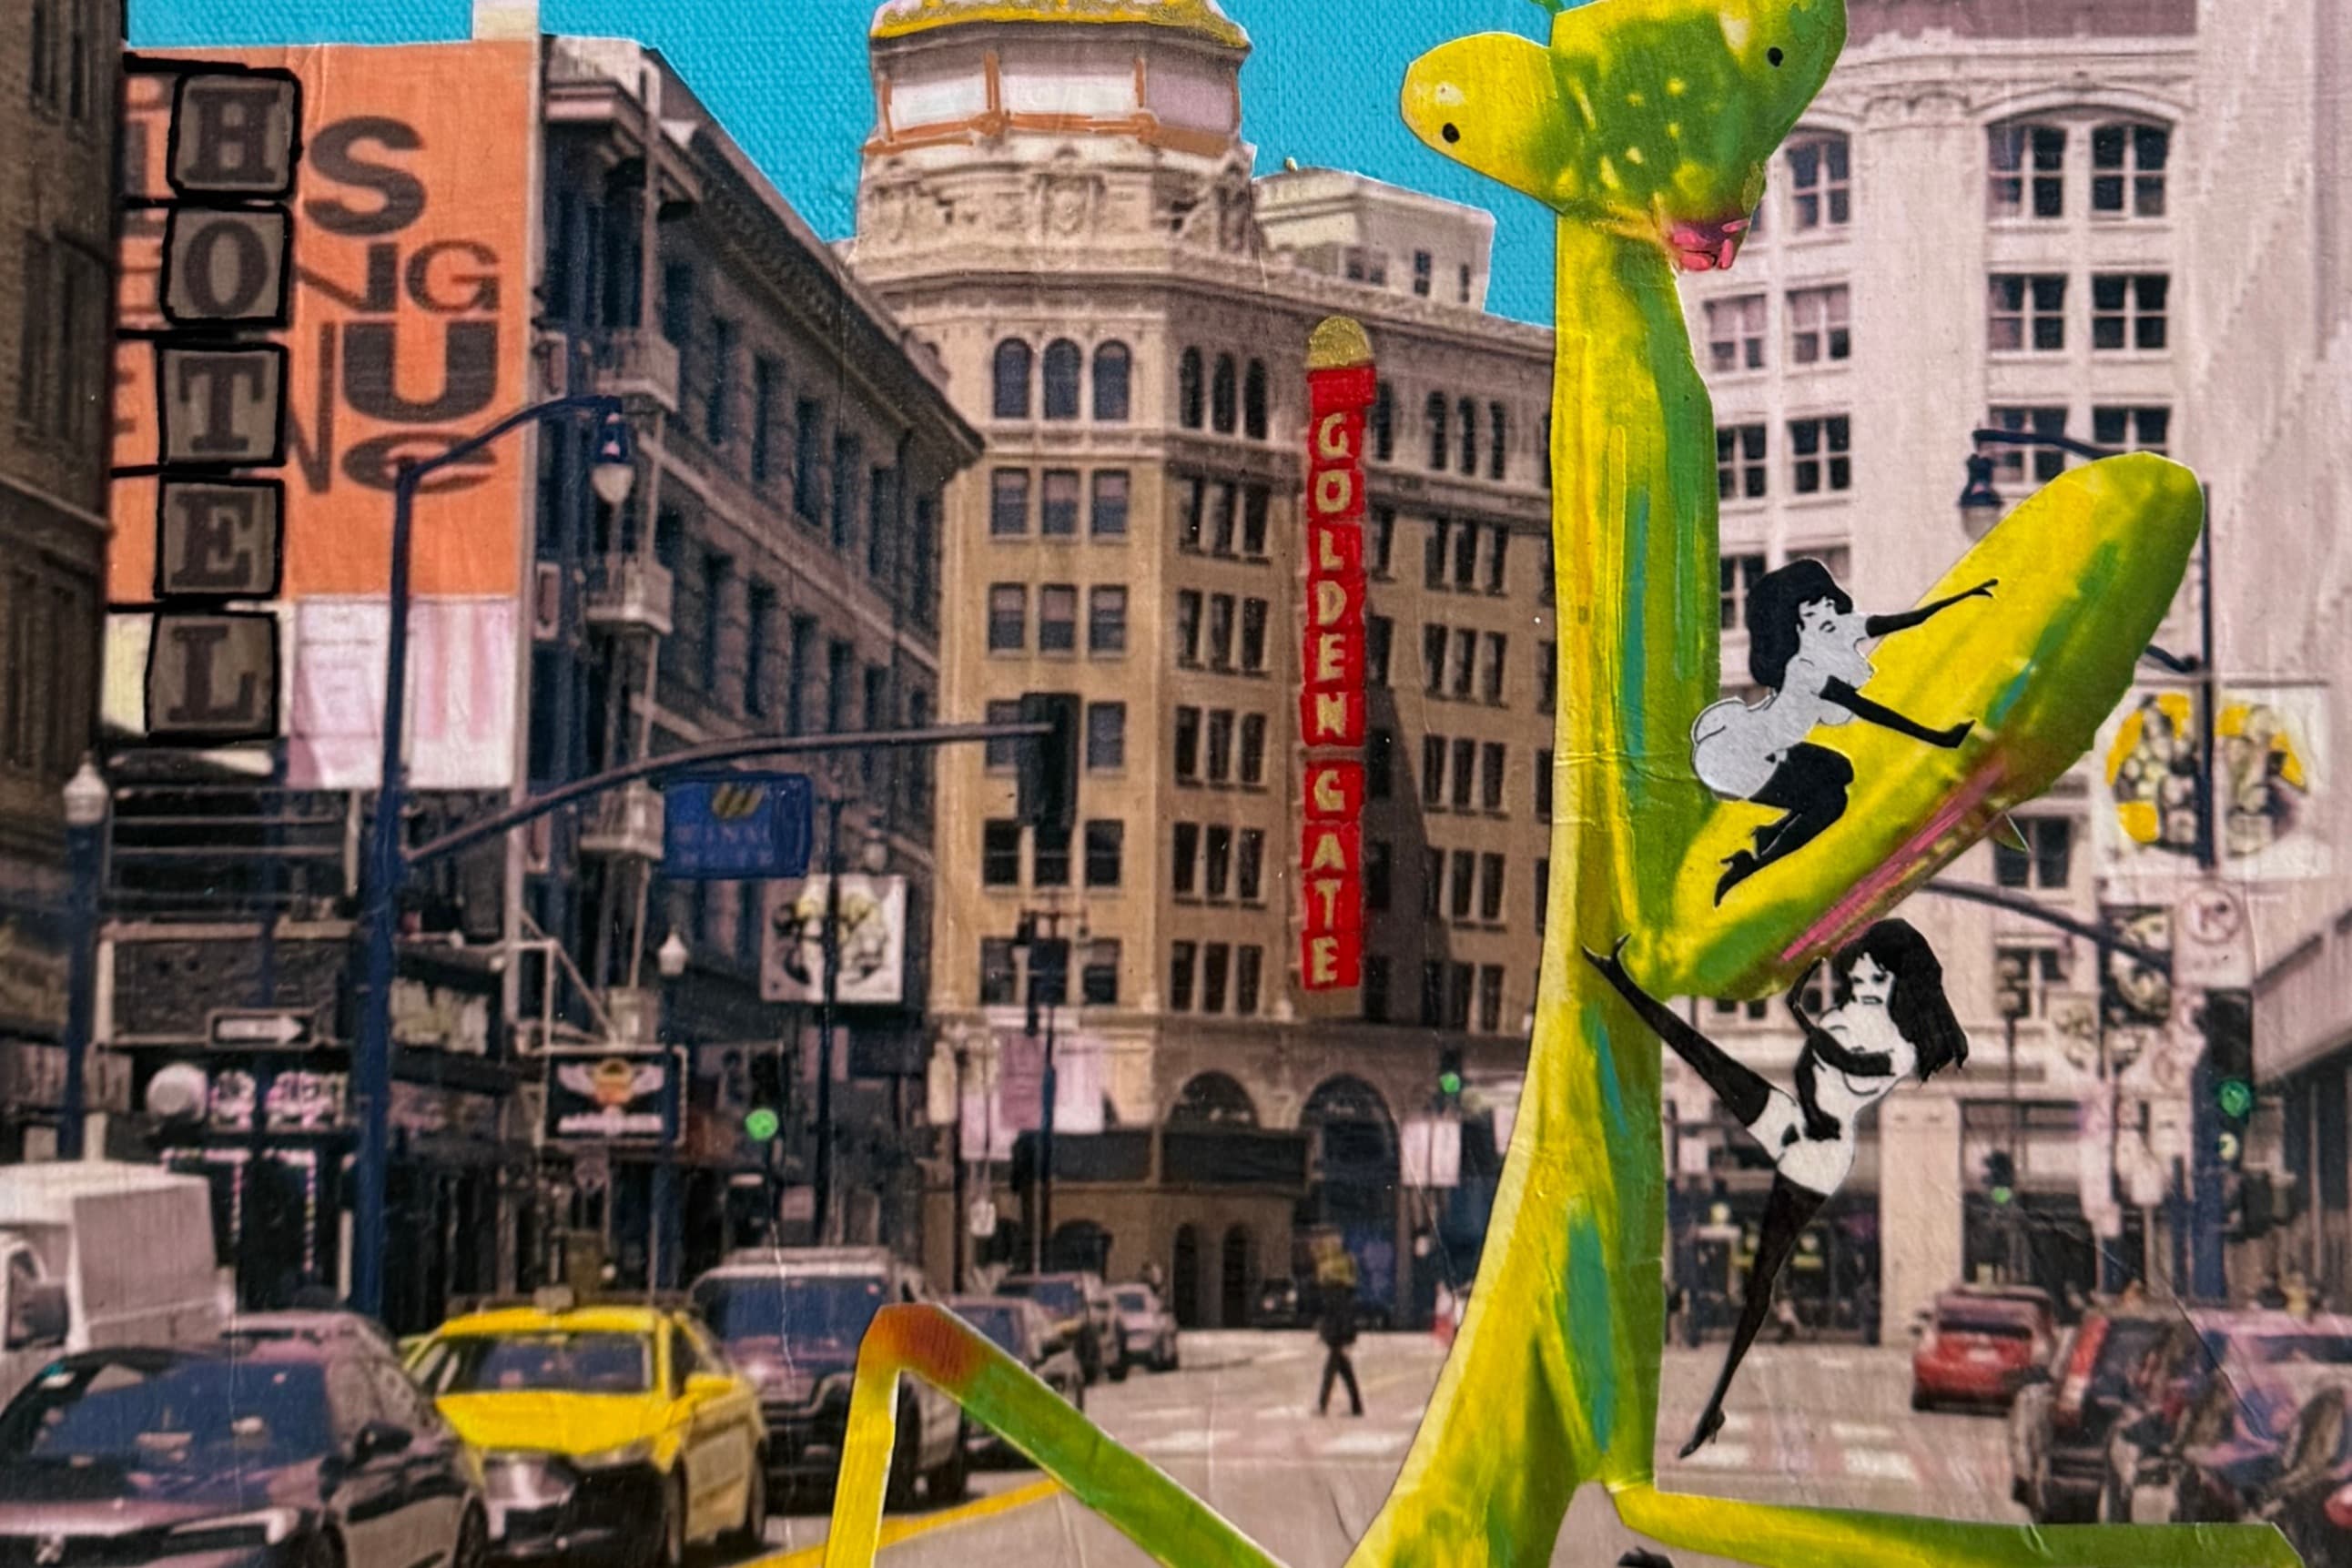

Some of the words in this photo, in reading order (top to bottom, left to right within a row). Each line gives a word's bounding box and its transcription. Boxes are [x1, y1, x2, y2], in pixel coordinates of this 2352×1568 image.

[167, 85, 281, 723] HOTEL
[1315, 411, 1353, 738] GOLDEN
[1311, 769, 1346, 984] GATE
